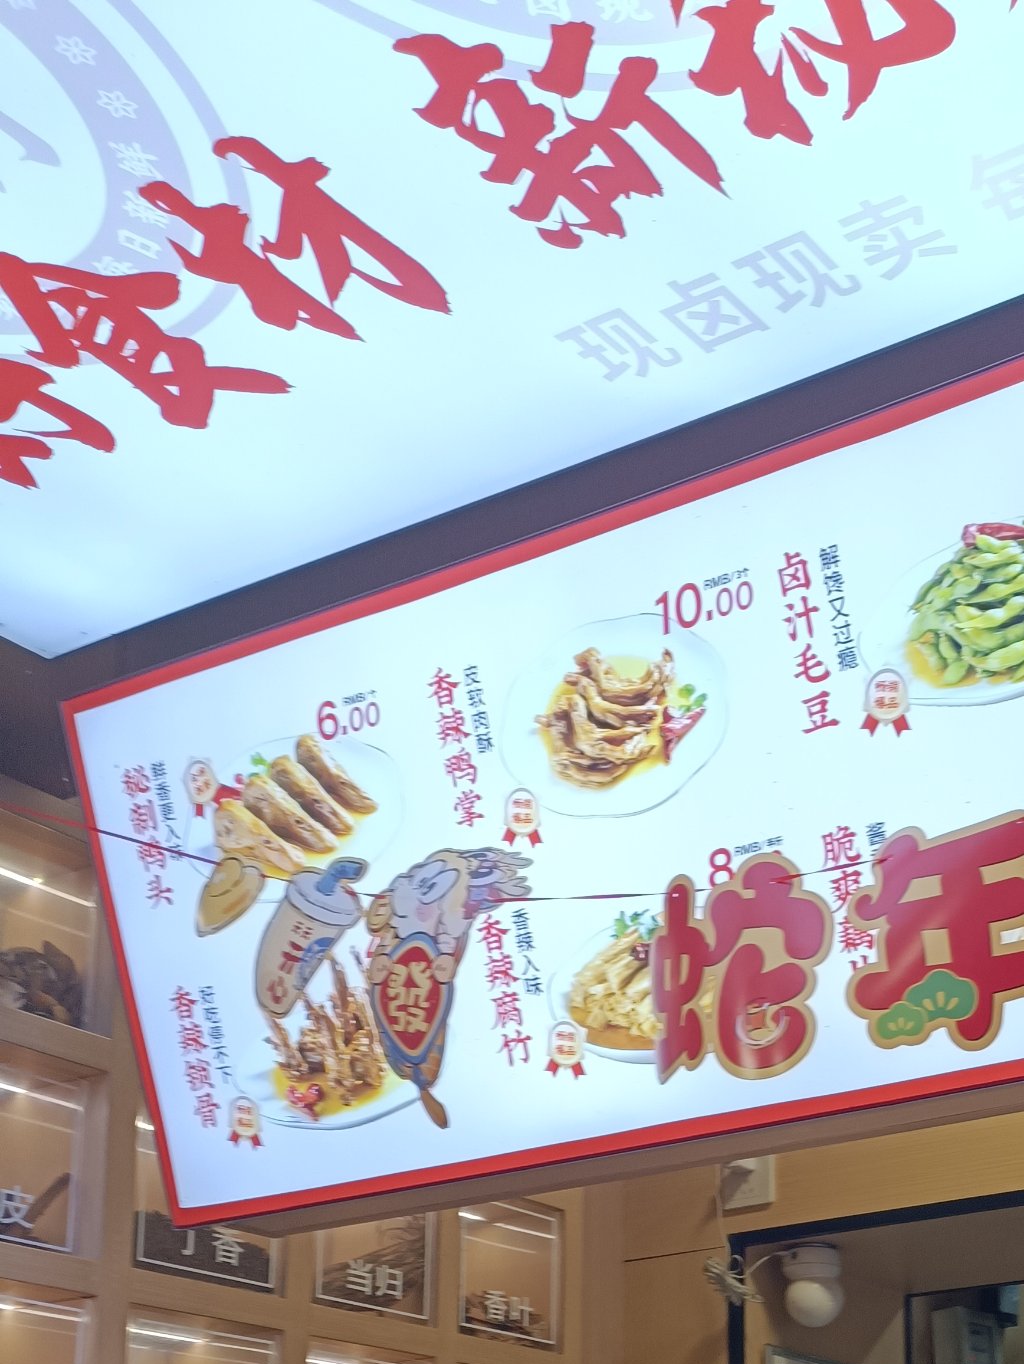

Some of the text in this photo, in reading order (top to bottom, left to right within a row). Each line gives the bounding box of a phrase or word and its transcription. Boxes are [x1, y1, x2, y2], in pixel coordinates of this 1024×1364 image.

[554, 194, 958, 383] 现卤现卖
[655, 581, 753, 635] 10.00
[778, 552, 840, 734] 卤汁毛豆
[317, 701, 380, 740] 6.00
[427, 667, 485, 827] 香辣鸭掌
[464, 664, 495, 754] 皮软肉酥
[476, 914, 532, 1066] 香辣腐竹
[169, 985, 220, 1128] 香辣锁骨
[346, 1259, 403, 1299] 当归
[484, 1290, 534, 1327] 香叶
